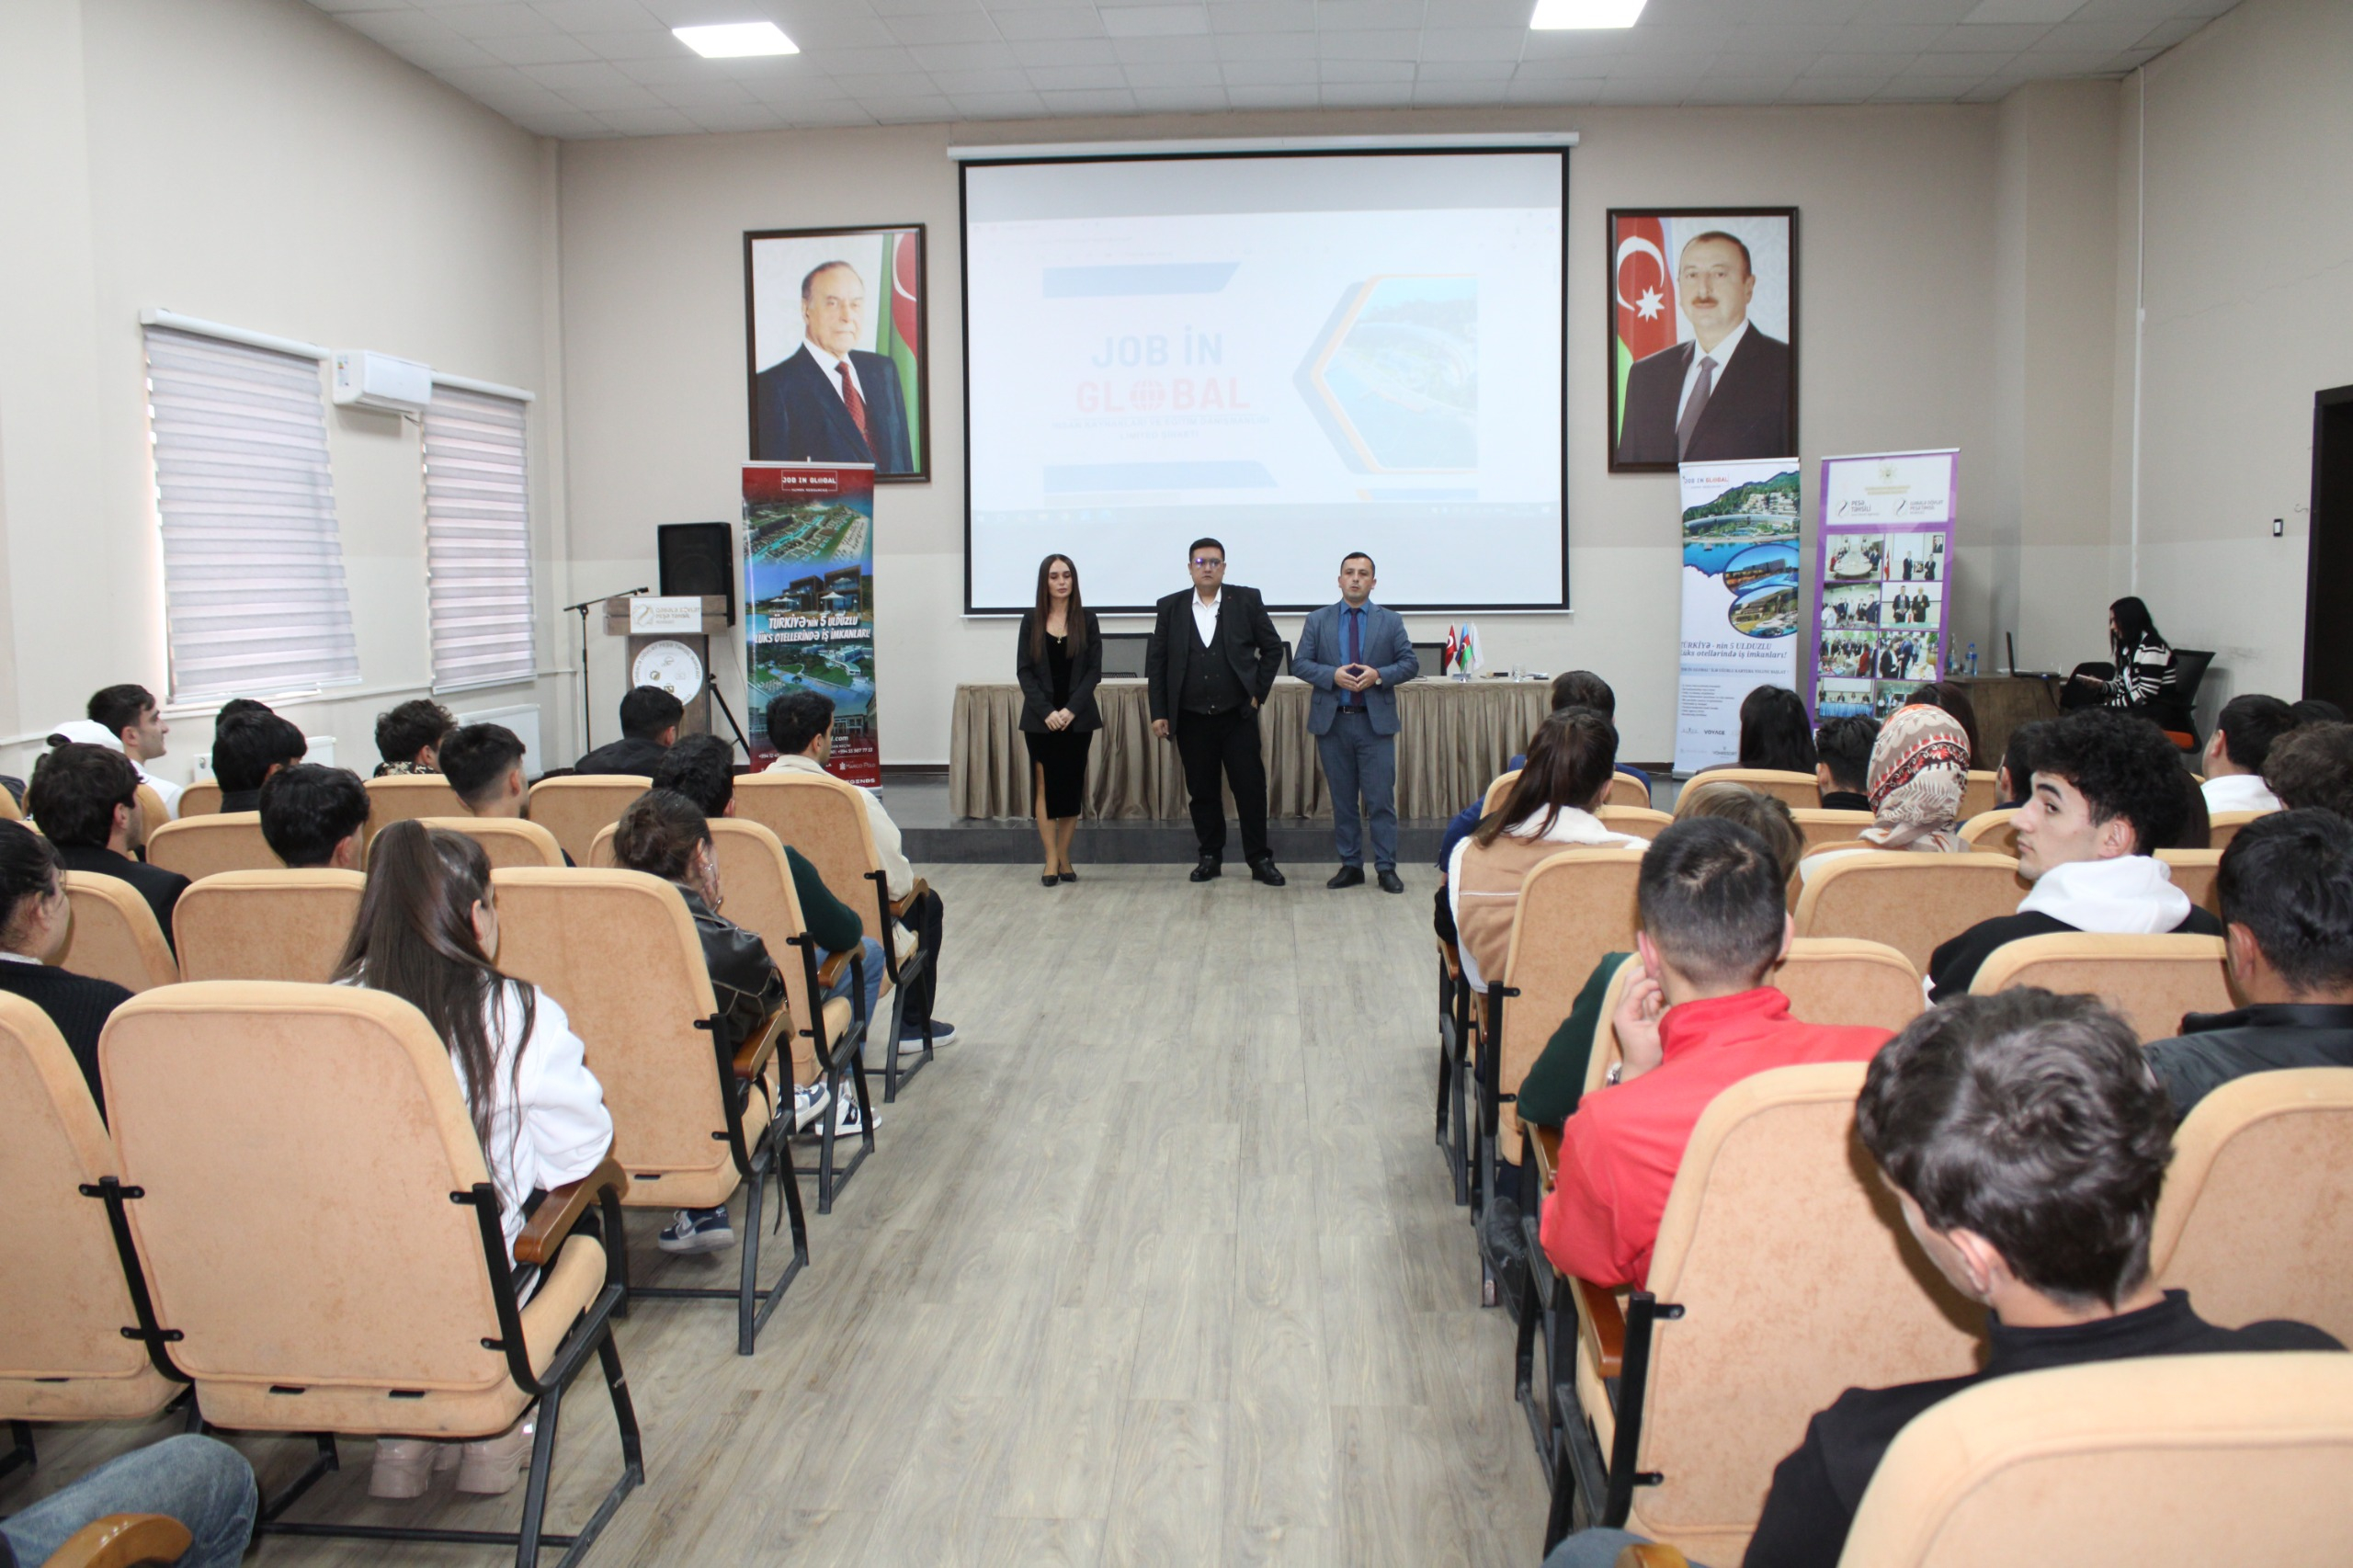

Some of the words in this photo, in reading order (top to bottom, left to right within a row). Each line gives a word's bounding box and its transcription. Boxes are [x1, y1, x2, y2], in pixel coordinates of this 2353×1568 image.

[1091, 333, 1169, 369] JOB
[1183, 324, 1222, 367] İN
[1075, 376, 1251, 413] GLOBAL
[1149, 418, 1162, 426] VE
[820, 615, 827, 627] 5
[828, 615, 858, 627] ULDUZLU
[755, 631, 773, 644] LÜKS
[822, 628, 829, 642] İŞ
